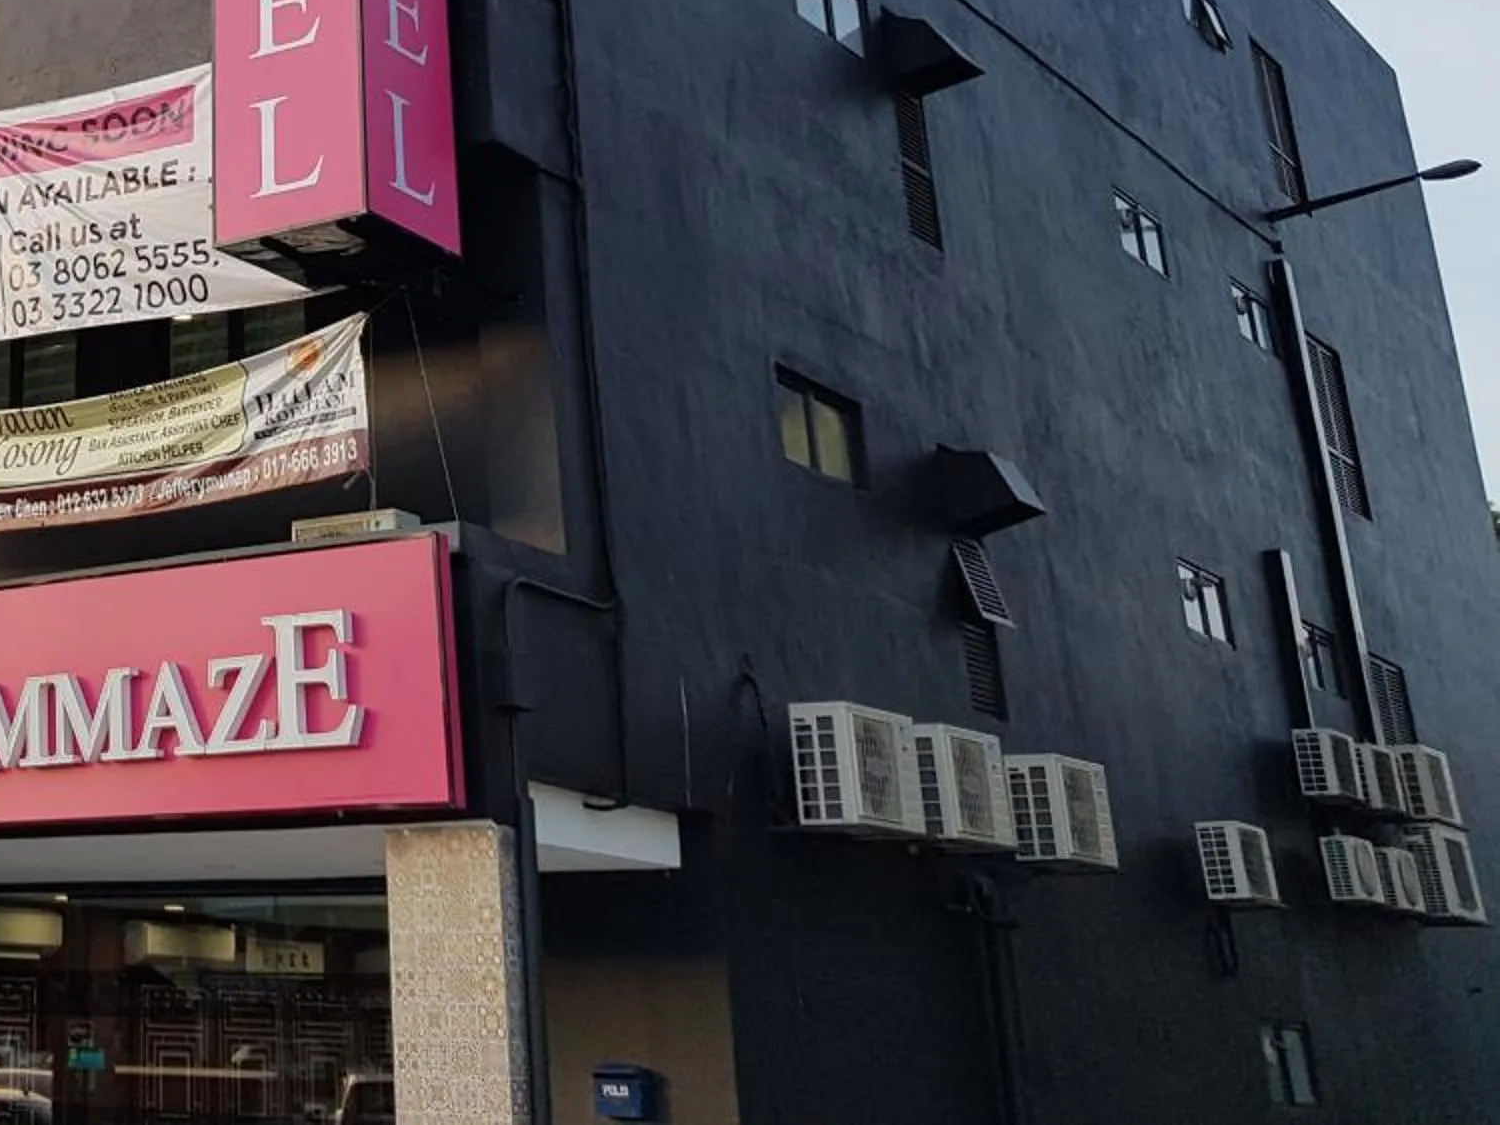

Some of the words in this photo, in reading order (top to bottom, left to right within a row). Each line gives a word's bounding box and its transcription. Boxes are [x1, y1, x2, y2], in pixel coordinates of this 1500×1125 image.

[80, 97, 186, 144] SOON
[17, 158, 179, 213] AVAILABLE
[8, 221, 61, 255] Call
[71, 223, 103, 247] us
[110, 213, 143, 242] at
[9, 261, 41, 292] 03
[53, 249, 127, 285] 8062
[11, 296, 44, 327] 03
[52, 286, 123, 321] 3322
[134, 274, 209, 311] 1000
[323, 437, 358, 466] 3913
